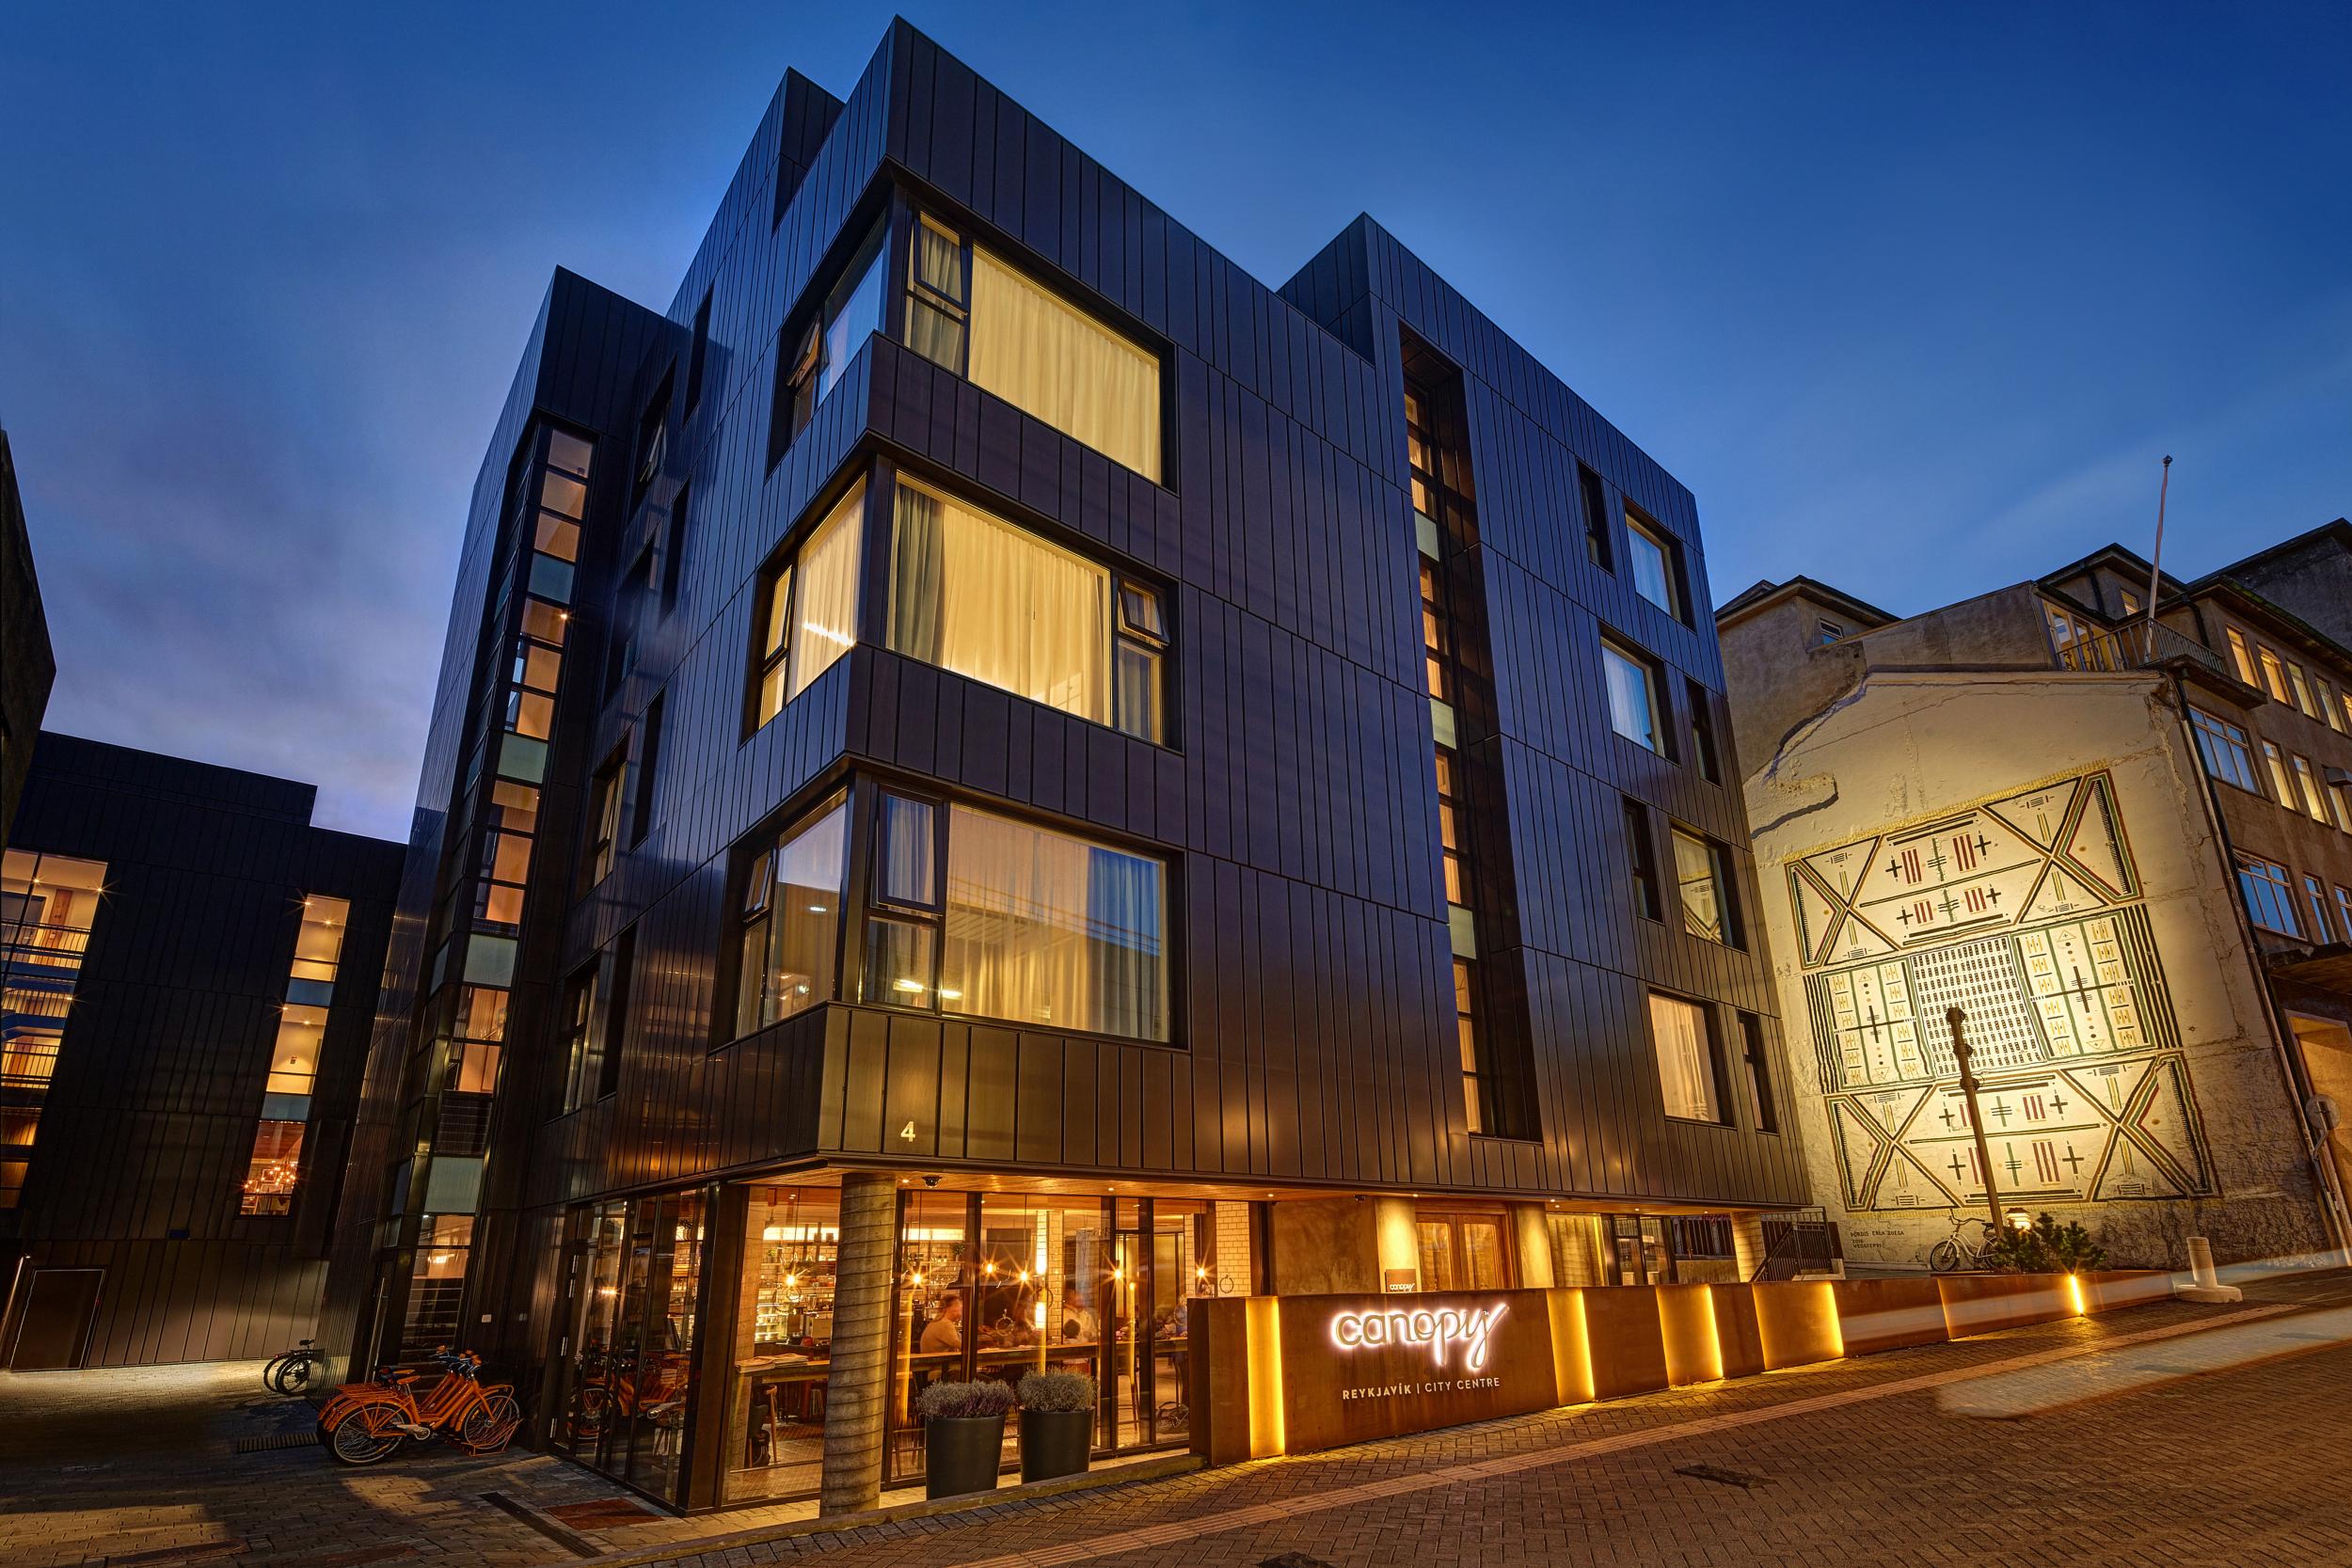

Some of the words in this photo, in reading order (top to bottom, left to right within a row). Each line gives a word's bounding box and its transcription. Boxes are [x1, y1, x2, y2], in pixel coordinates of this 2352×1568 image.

[900, 1120, 916, 1143] 4
[1390, 1282, 1415, 1293] canopy
[1335, 1303, 1510, 1370] canopy
[1343, 1383, 1412, 1401] REYKJAVÍK
[1424, 1381, 1452, 1393] CITY
[1457, 1377, 1501, 1390] CENTRE
